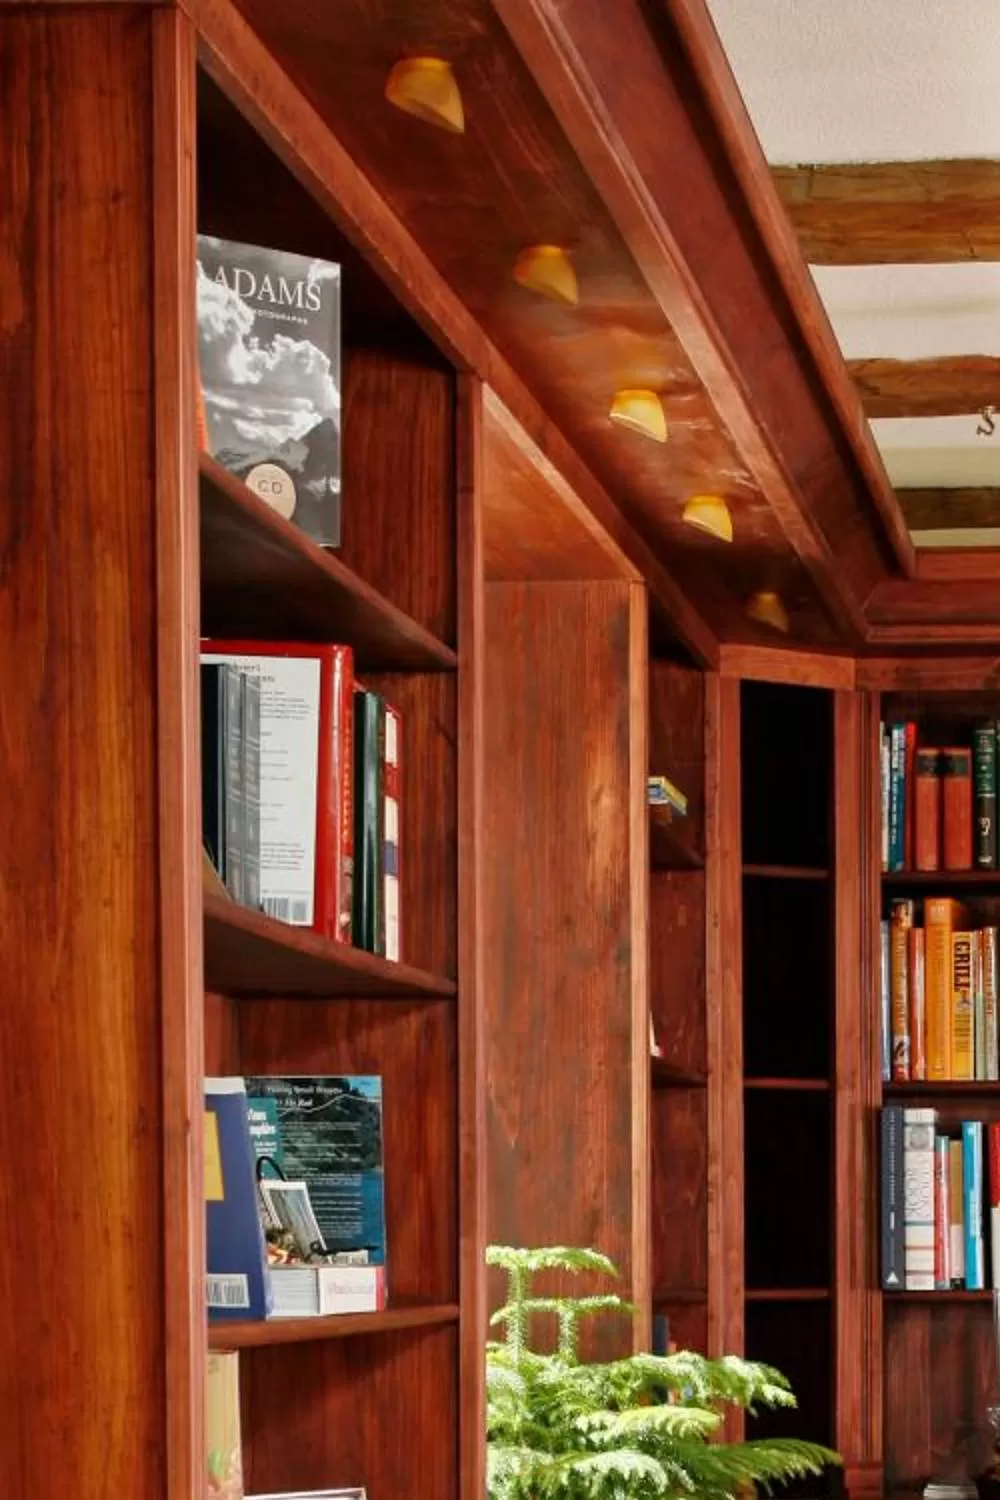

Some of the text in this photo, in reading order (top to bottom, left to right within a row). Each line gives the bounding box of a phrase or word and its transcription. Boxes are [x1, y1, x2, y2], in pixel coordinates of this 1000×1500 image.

[213, 264, 322, 312] ADAMS
[257, 478, 283, 496] CD
[953, 941, 971, 992] GRILL
